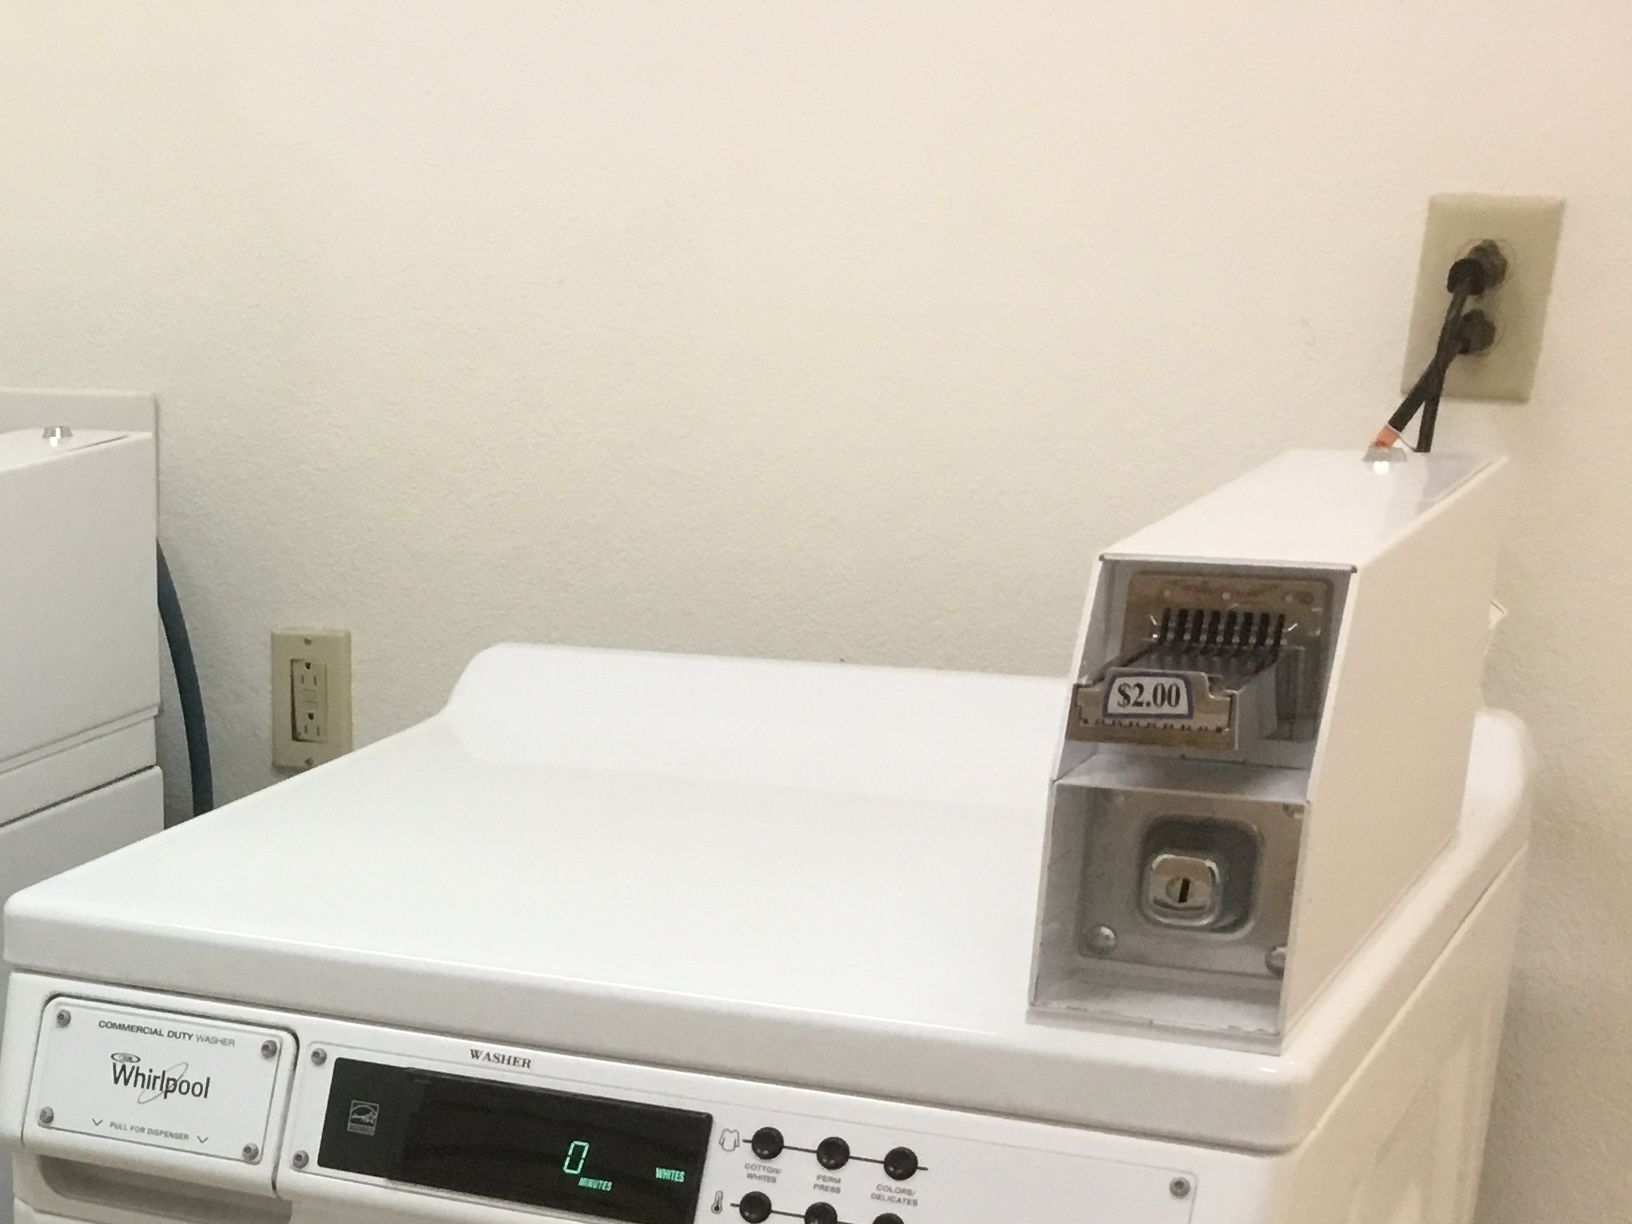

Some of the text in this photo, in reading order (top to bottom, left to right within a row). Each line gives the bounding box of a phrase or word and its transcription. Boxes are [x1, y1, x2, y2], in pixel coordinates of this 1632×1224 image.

[1117, 682, 1181, 708] $2.00
[98, 1019, 236, 1048] COMMERCIAL DUTY WASHER
[469, 1049, 532, 1069] WASHER
[111, 1061, 211, 1100] Whirlpool
[110, 1121, 128, 1131] PULL
[130, 1125, 145, 1134] FOR
[563, 1140, 590, 1175] 0
[655, 1166, 686, 1183] WHITES
[816, 1174, 842, 1184] PERM
[813, 1183, 841, 1194] PRESS
